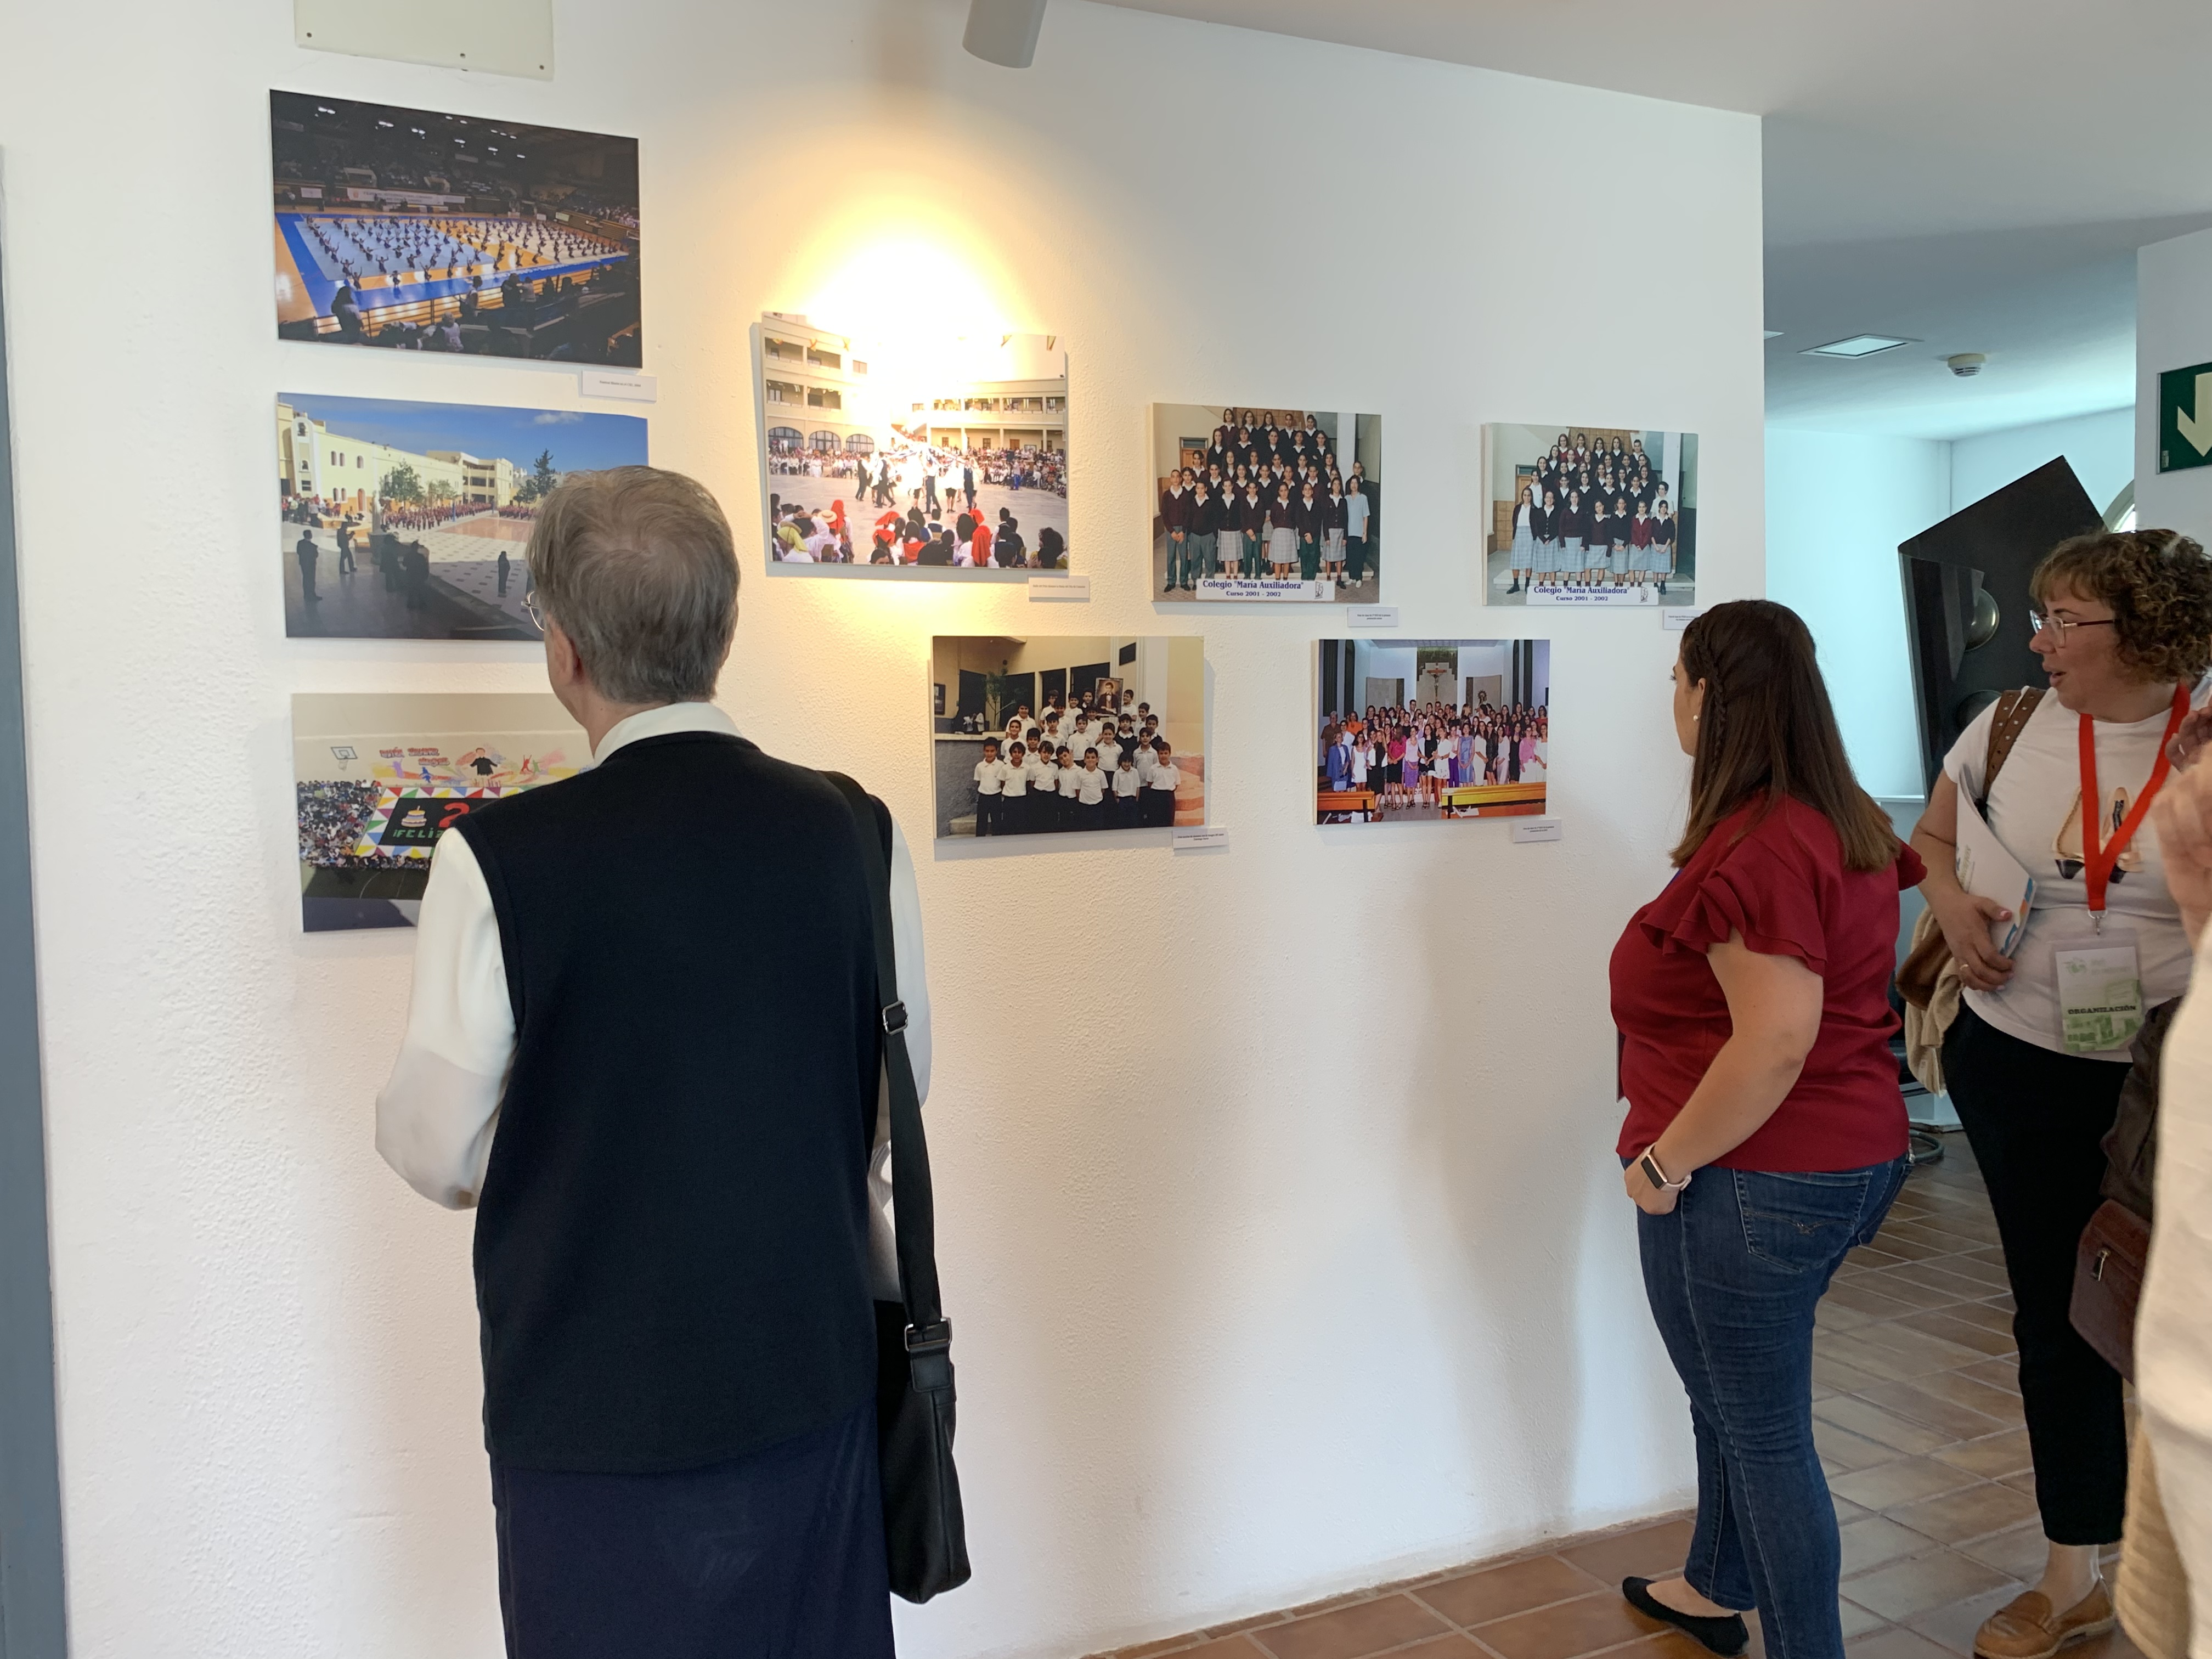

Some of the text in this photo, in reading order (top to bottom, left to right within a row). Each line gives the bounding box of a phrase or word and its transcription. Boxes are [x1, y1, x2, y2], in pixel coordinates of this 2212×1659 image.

[1203, 580, 1232, 590] Colegio
[1234, 580, 1257, 589] "María
[1534, 586, 1562, 595] Colegio
[2068, 1005, 2136, 1014] ORGANIZACIÓN
